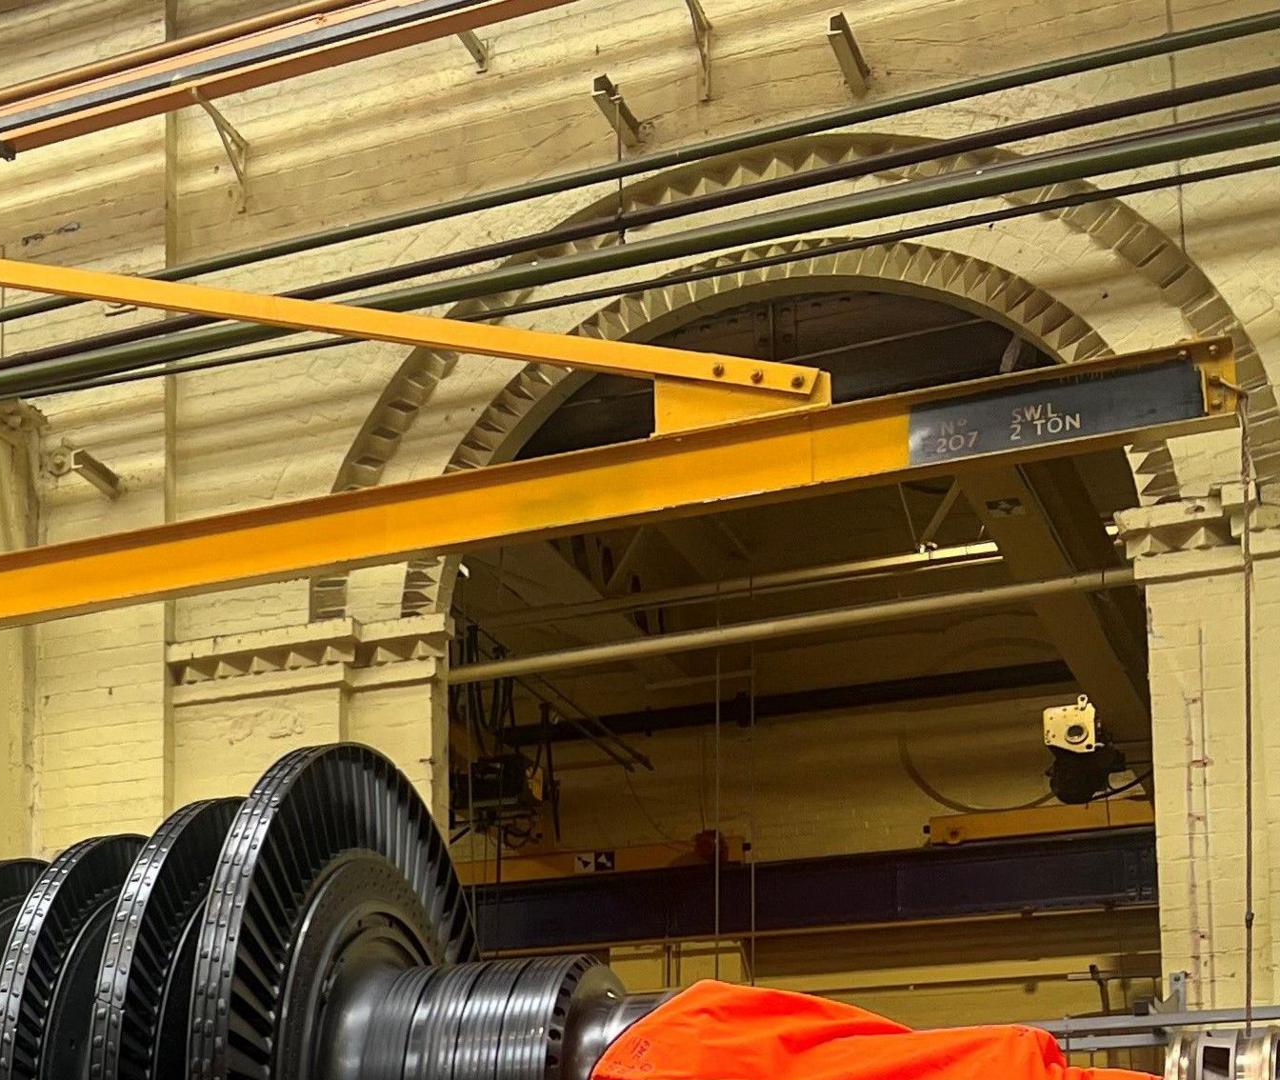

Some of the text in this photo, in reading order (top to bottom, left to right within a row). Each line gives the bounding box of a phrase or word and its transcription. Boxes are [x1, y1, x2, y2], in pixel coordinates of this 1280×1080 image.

[1009, 413, 1081, 441] 2 TON
[937, 431, 979, 454] 207
